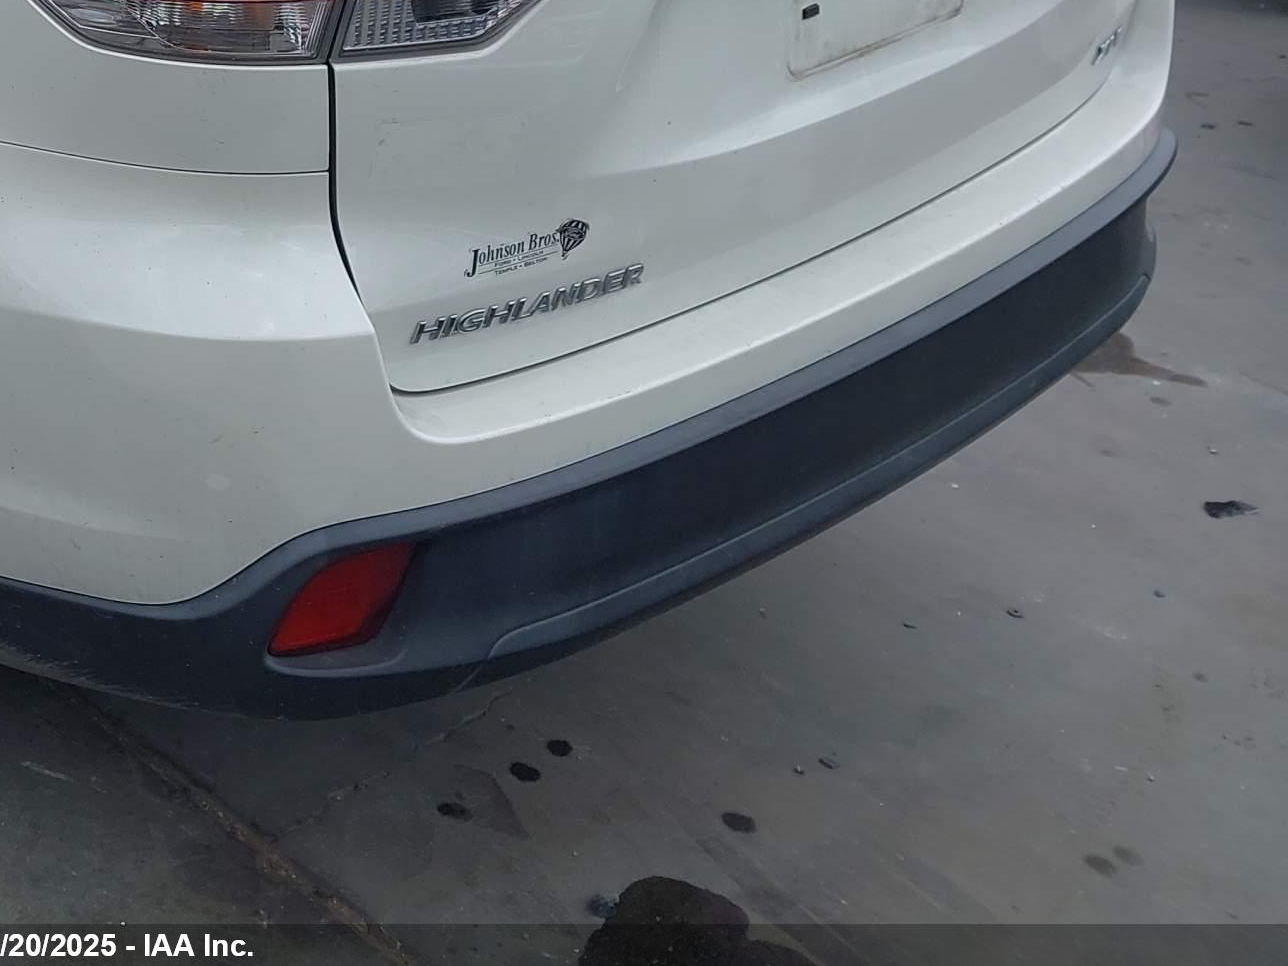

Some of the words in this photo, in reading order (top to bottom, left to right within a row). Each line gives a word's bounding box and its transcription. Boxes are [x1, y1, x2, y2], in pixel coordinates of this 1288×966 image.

[464, 240, 525, 278] Johnson
[528, 232, 560, 251] Bros.
[409, 263, 644, 345] HIGHLANDER
